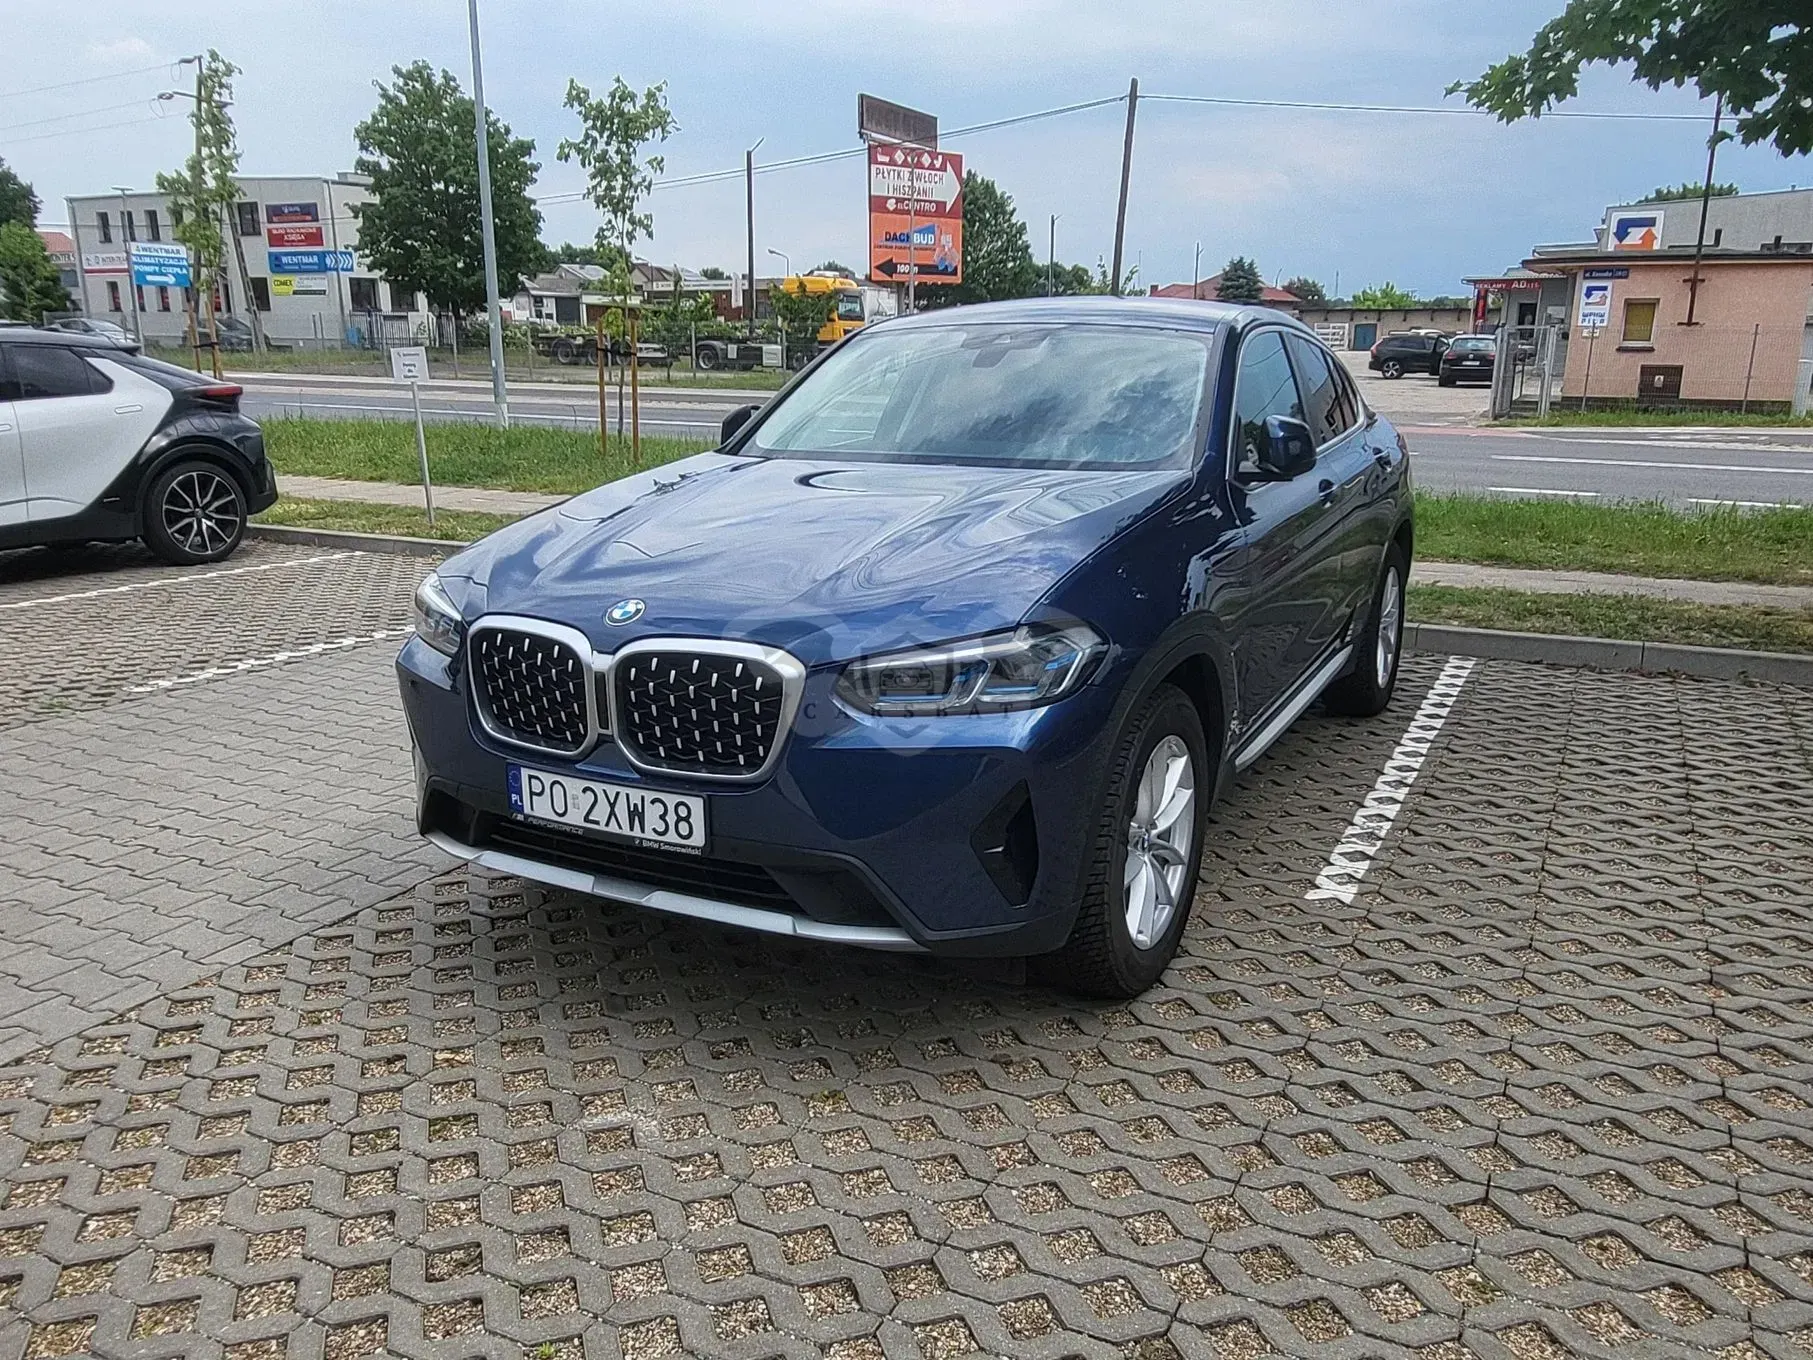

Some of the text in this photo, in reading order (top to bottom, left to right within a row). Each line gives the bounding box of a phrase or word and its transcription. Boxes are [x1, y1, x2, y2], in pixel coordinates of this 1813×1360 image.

[875, 167, 905, 181] PŁYTKI
[914, 171, 944, 185] WŁOCH
[892, 184, 934, 199] HISZPANII
[141, 246, 182, 256] WENTMAR
[132, 255, 188, 266] KLIMATYZACJA
[281, 255, 319, 264] WENTMAR
[134, 264, 188, 275] POMPY CIEPŁA
[896, 264, 910, 274] 100
[273, 279, 293, 287] COMEX
[511, 793, 523, 806] PL
[527, 773, 694, 841] PO 2XW38
[642, 839, 659, 849] BMW
